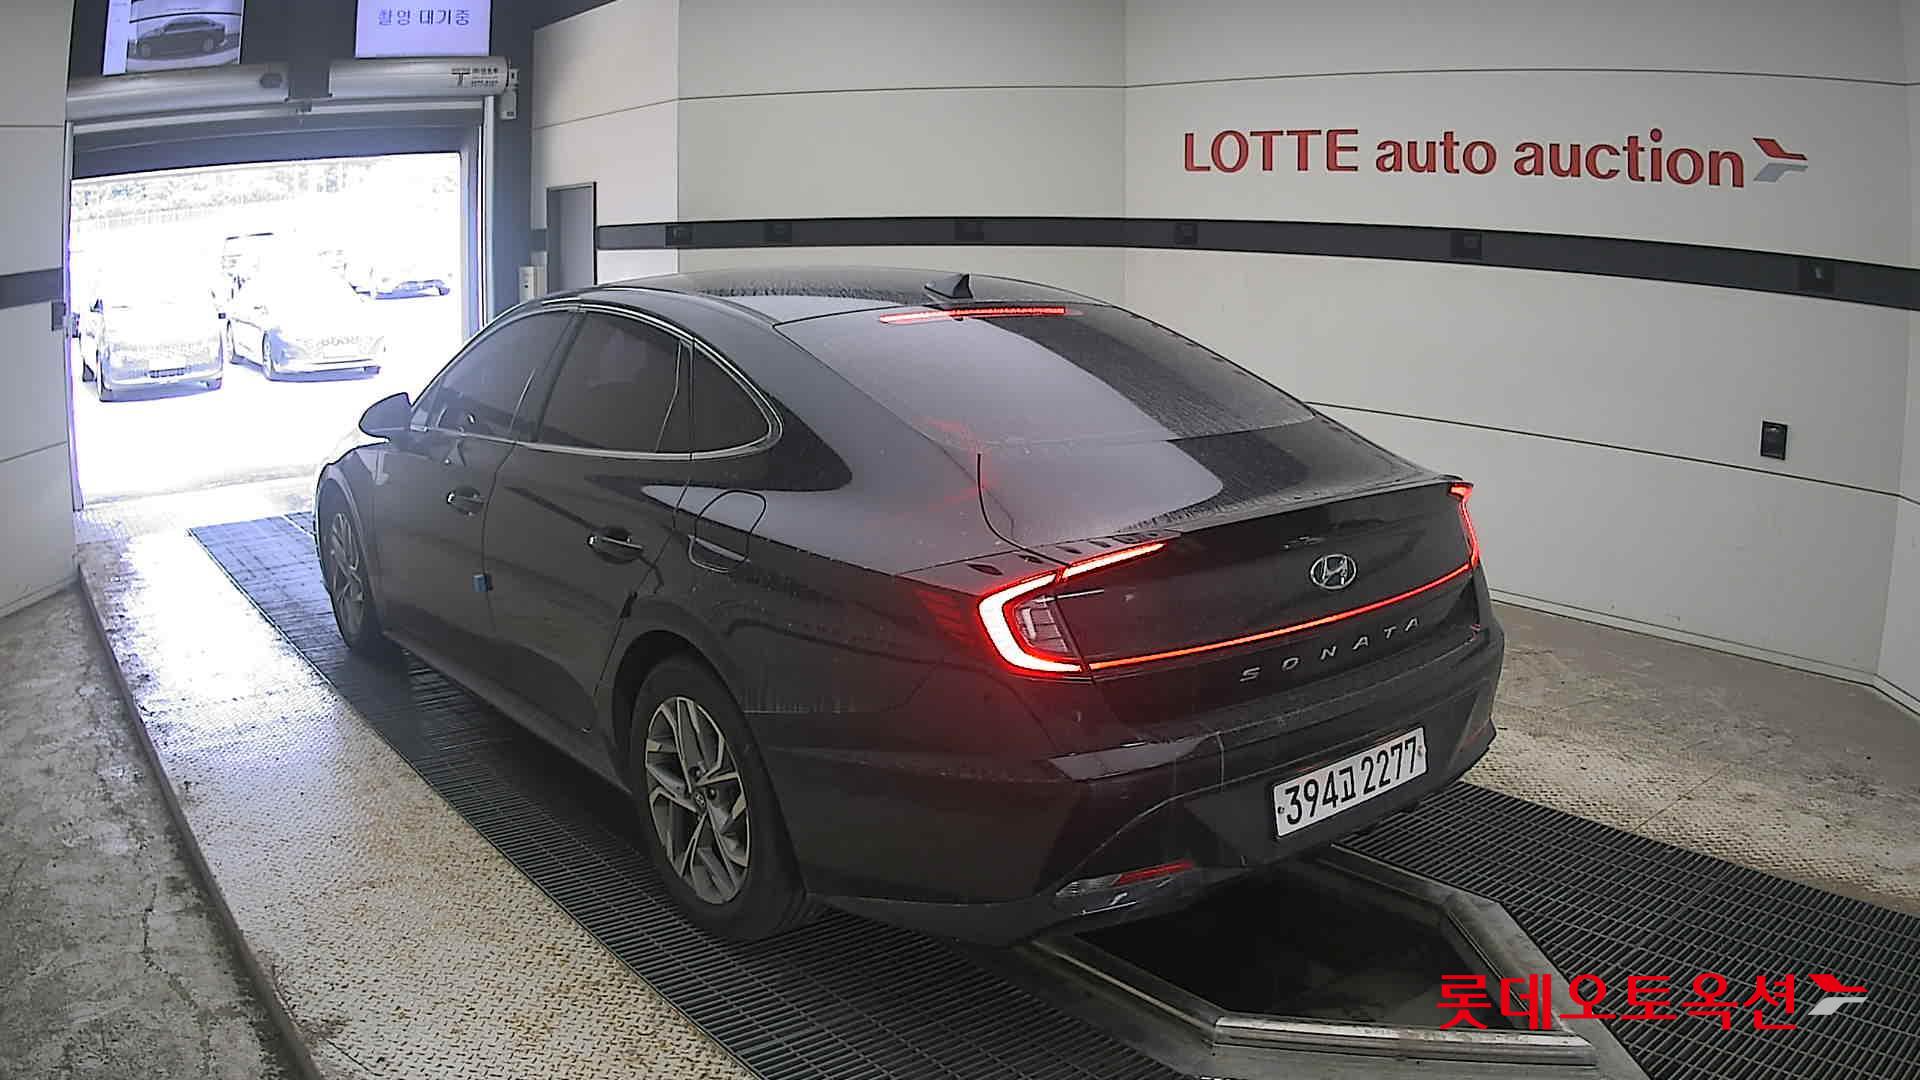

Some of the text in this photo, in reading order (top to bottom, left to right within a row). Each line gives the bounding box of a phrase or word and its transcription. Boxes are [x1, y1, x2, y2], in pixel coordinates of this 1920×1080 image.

[419, 8, 470, 26] 대기중
[1184, 127, 1745, 188] LOTTE auto auction
[1239, 616, 1420, 683] SONATA
